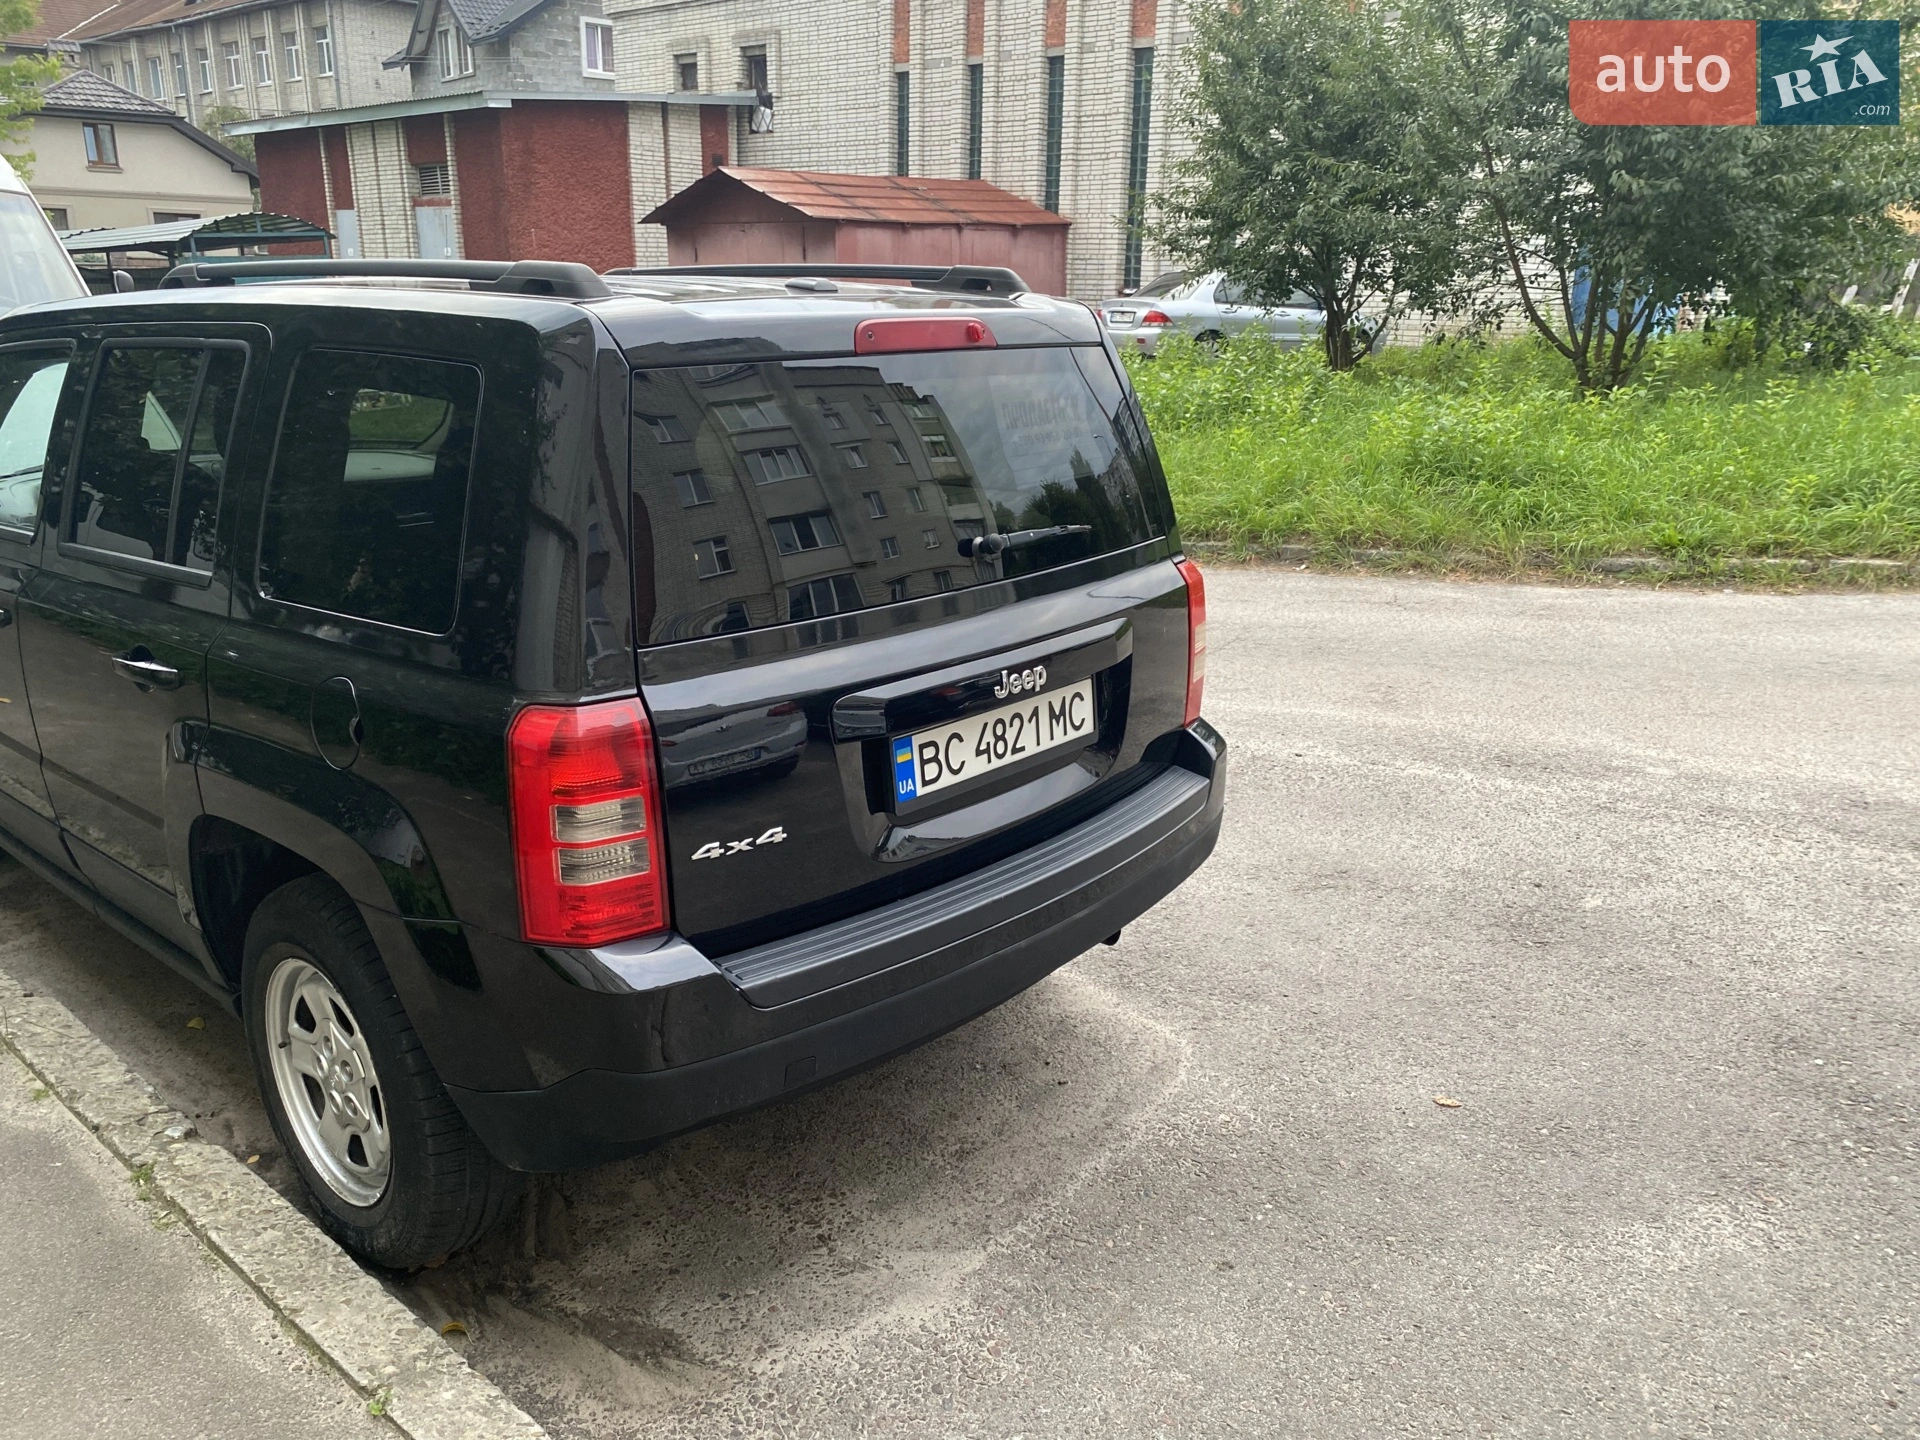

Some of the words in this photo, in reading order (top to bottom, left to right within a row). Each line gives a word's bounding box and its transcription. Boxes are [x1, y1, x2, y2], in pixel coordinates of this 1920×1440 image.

[994, 665, 1047, 699] Jeep
[918, 732, 966, 788] BC
[975, 705, 1041, 764] 4821
[1048, 691, 1086, 742] MC
[899, 780, 915, 795] UA
